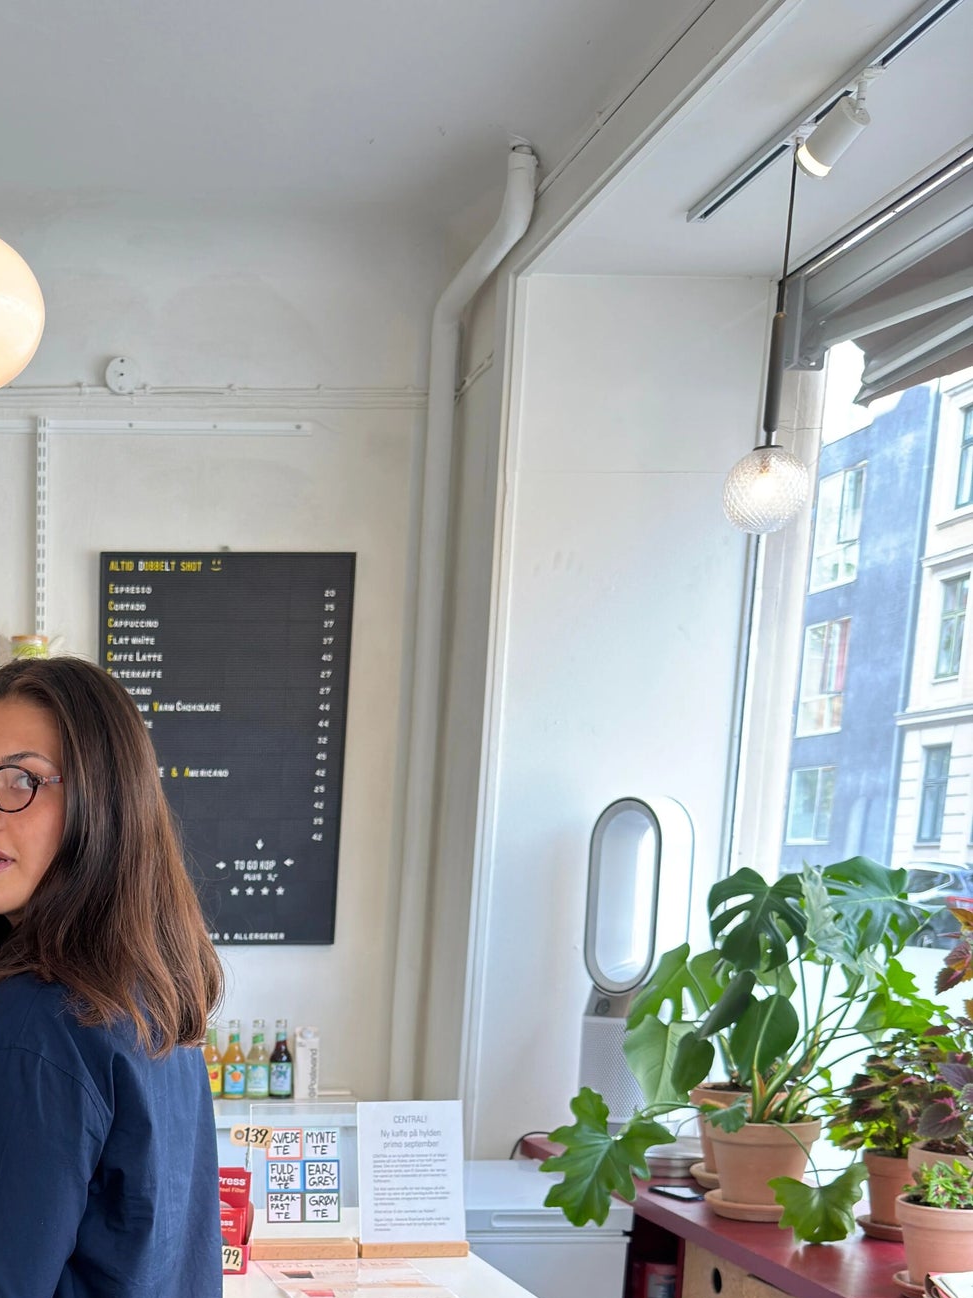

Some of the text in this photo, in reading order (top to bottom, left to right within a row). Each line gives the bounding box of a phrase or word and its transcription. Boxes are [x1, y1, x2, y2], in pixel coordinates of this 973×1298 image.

[109, 560, 134, 571] ALTID
[180, 561, 203, 571] SHOT
[107, 635, 129, 645] FLAT
[136, 651, 163, 661] LATTE
[234, 860, 245, 870] TO
[246, 860, 258, 870] GO
[306, 1132, 337, 1143] MYNTE
[381, 1129, 390, 1138] Ny
[392, 1129, 407, 1137] kaffe
[409, 1130, 418, 1138] på
[274, 1145, 290, 1155] TE
[313, 1145, 327, 1155] TE
[270, 1164, 298, 1174] FULD-
[308, 1164, 335, 1176] EARL
[308, 1176, 337, 1187] GREY
[270, 1194, 300, 1202] BREAK-
[309, 1195, 338, 1206] GRØN
[270, 1203, 290, 1211] FAST
[275, 1212, 291, 1220] TE
[313, 1209, 329, 1218] TE
